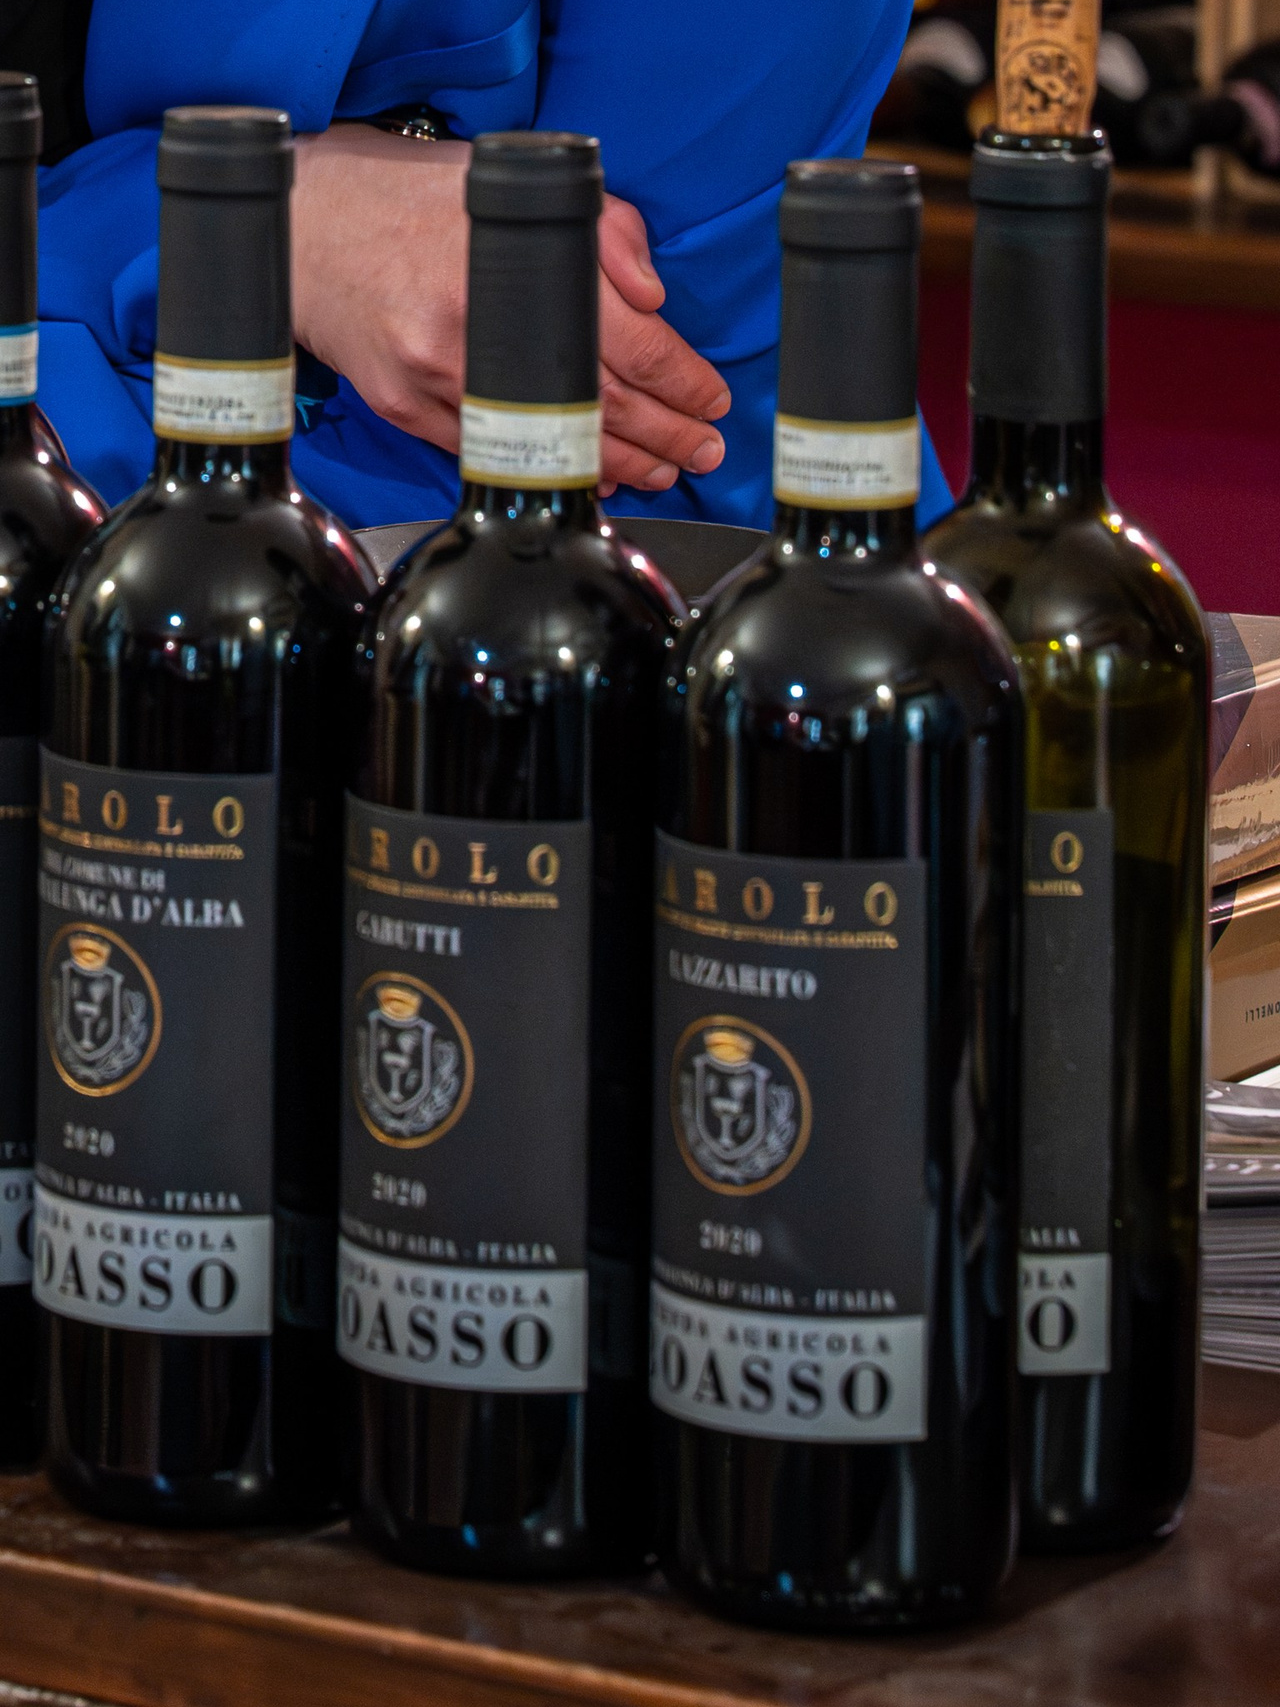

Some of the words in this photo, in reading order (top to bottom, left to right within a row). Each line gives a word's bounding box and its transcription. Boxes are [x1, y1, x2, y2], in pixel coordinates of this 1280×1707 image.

[37, 1229, 239, 1316] OASSO
[341, 1284, 553, 1372] OASSO
[661, 1332, 893, 1422] OASSO
